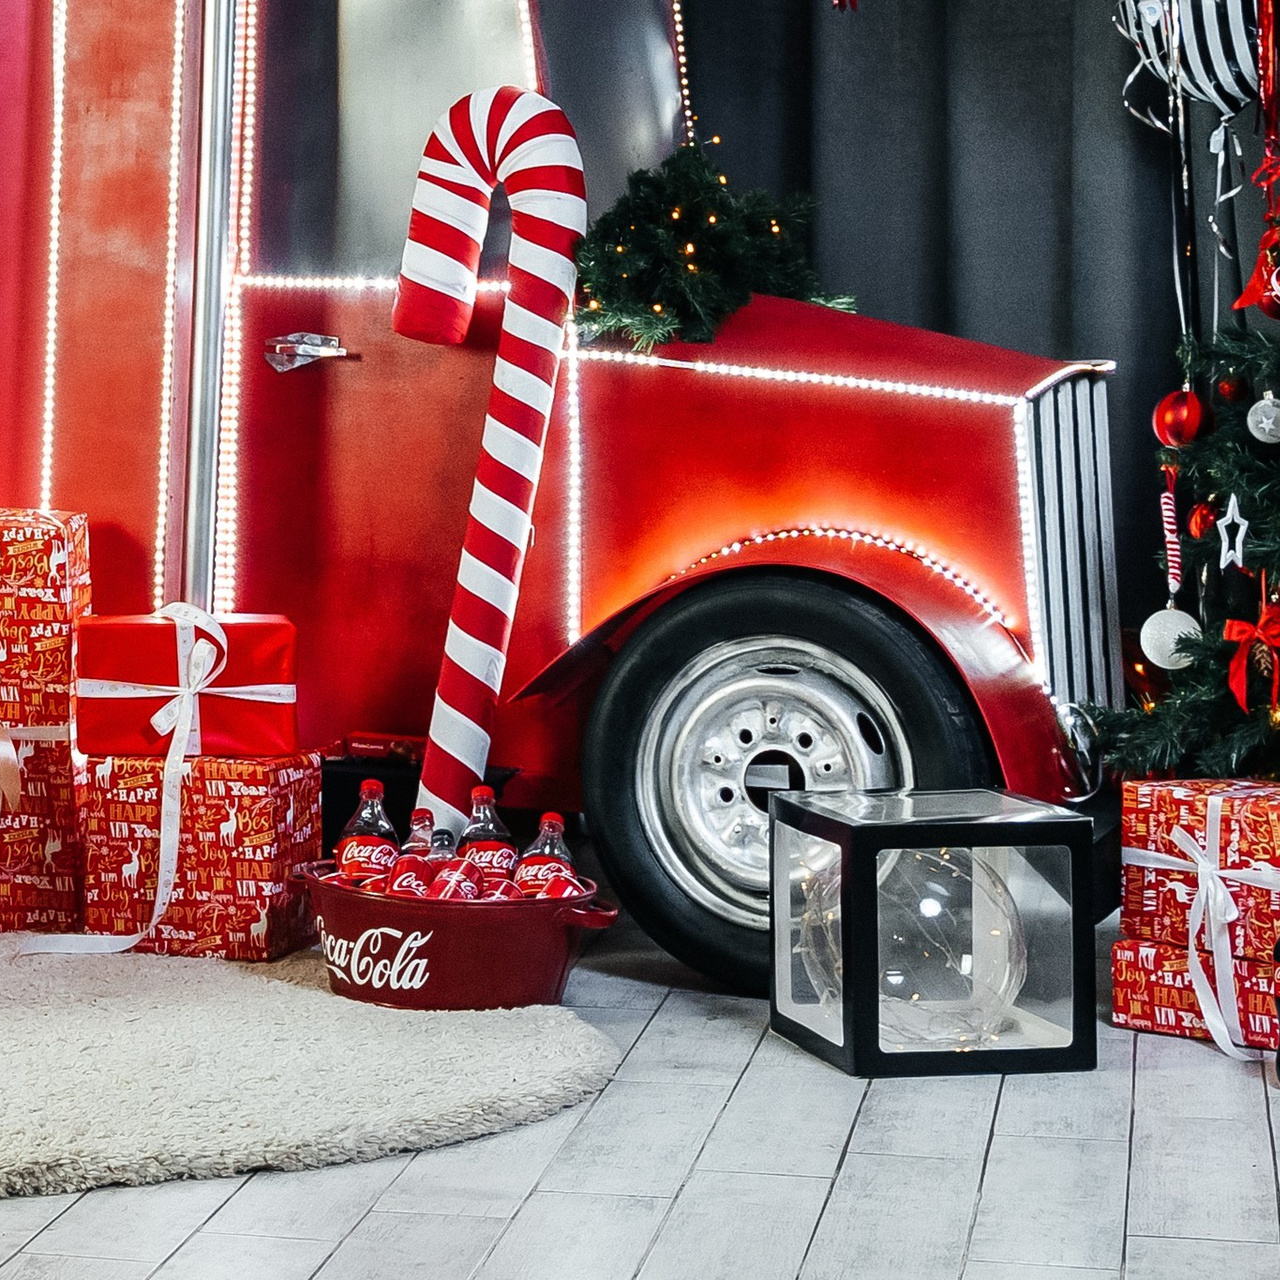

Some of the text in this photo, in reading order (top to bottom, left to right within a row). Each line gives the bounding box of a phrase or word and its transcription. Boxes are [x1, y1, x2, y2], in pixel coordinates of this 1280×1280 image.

[2, 527, 43, 542] HAPPY
[7, 553, 49, 580] Best
[19, 587, 58, 602] Year
[19, 603, 66, 621] APPY
[0, 617, 28, 645] Joy
[30, 623, 70, 638] HAPPY
[45, 683, 69, 693] ear
[204, 763, 264, 779] HAPPY
[118, 788, 158, 803] HAPPY
[227, 782, 267, 796] Year
[0, 814, 39, 829] HAPPY
[109, 803, 158, 822] HAPP
[131, 824, 160, 838] Yea
[1245, 803, 1271, 860] Best
[1227, 820, 1240, 866] Year
[5, 842, 43, 868] Best
[200, 842, 228, 870] Joy
[342, 841, 399, 867] Coca-Col
[236, 862, 272, 879] HAP
[101, 882, 130, 910] Joy
[1128, 868, 1142, 910] HAP
[26, 910, 66, 923] HAPPY
[197, 909, 223, 934] est
[158, 925, 196, 940] Year
[1235, 925, 1245, 957] ear
[1117, 960, 1146, 993] Joy
[1164, 972, 1193, 988] HAP
[1154, 987, 1199, 1010] HAP
[1154, 1006, 1176, 1026] NEW
[1249, 1014, 1270, 1033] NEW
